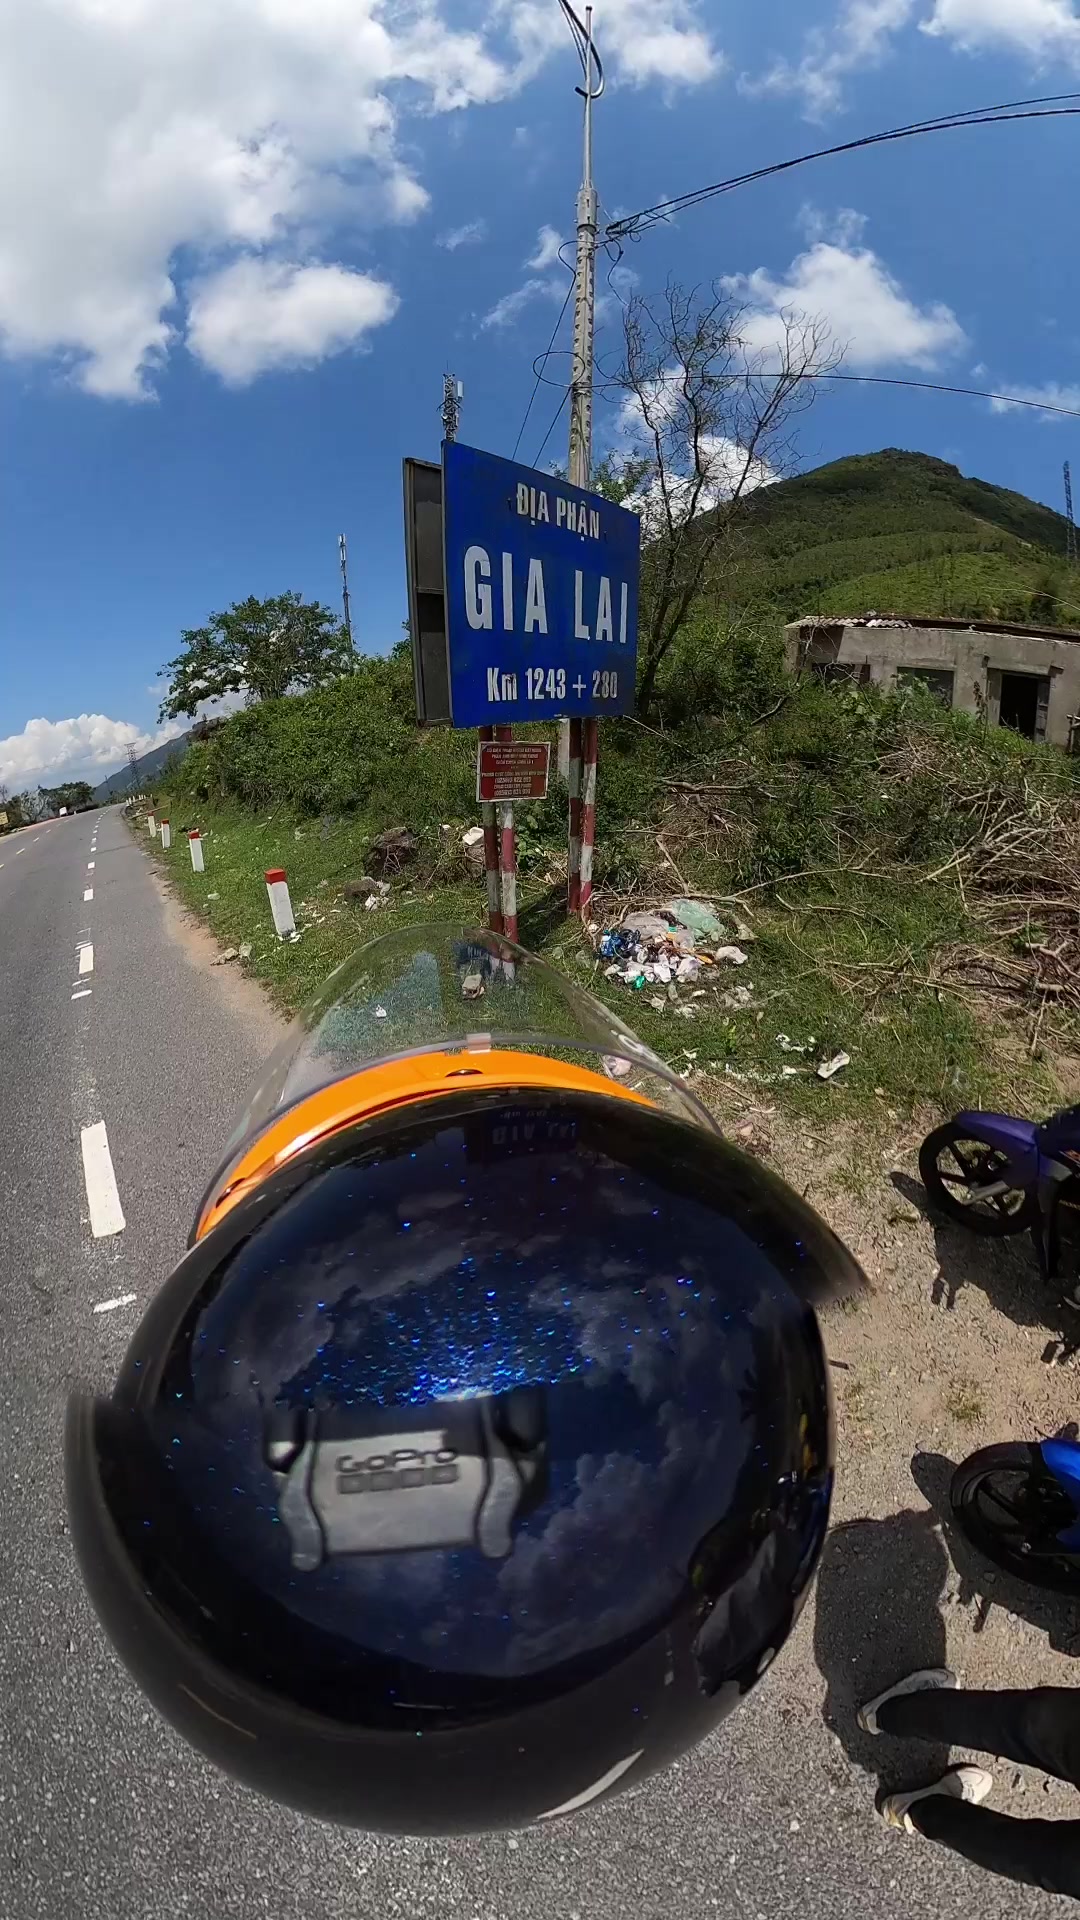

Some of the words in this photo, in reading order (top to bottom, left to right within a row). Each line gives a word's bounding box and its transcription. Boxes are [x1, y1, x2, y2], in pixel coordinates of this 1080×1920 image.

[516, 482, 550, 526] ĐỊA
[556, 496, 600, 542] PHẬN
[464, 545, 548, 634] GIA
[574, 569, 628, 644] LAI
[487, 667, 518, 702] Km
[525, 667, 566, 700] 1243
[592, 670, 618, 699] 280
[336, 1448, 459, 1473] GoPro
